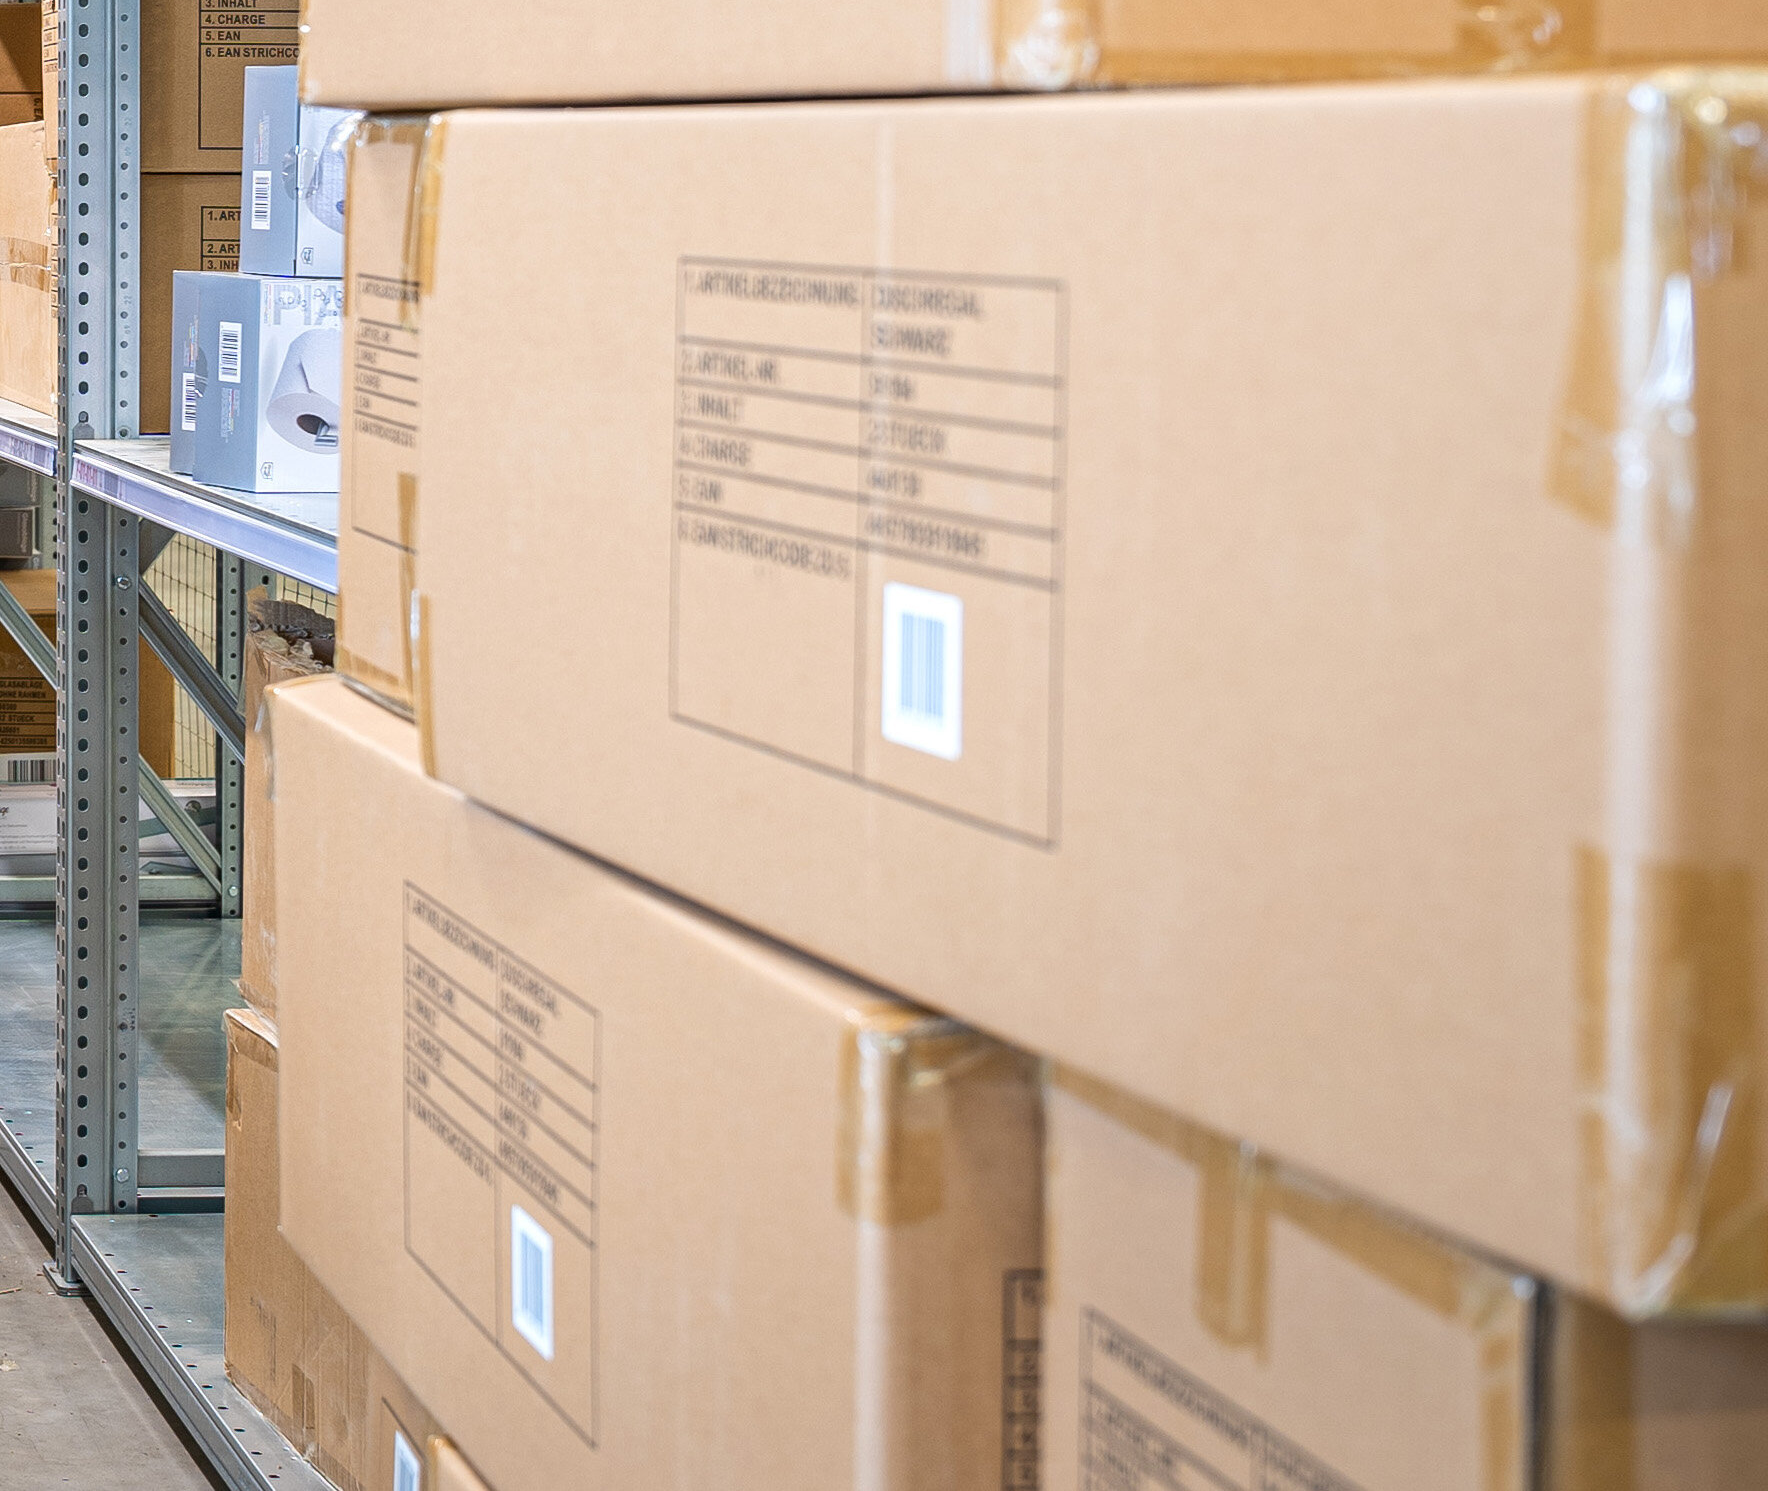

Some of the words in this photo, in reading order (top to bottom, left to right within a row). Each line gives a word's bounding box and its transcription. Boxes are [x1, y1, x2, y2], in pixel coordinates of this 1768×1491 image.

[205, 14, 216, 25] 4.
[217, 14, 266, 25] CHARGE
[205, 31, 216, 41] 5.
[217, 31, 241, 41] EAN
[205, 47, 216, 58] 6.
[217, 47, 241, 58] EAN
[207, 210, 218, 221] 1.
[207, 244, 218, 255] 2.
[207, 260, 217, 271] 3.
